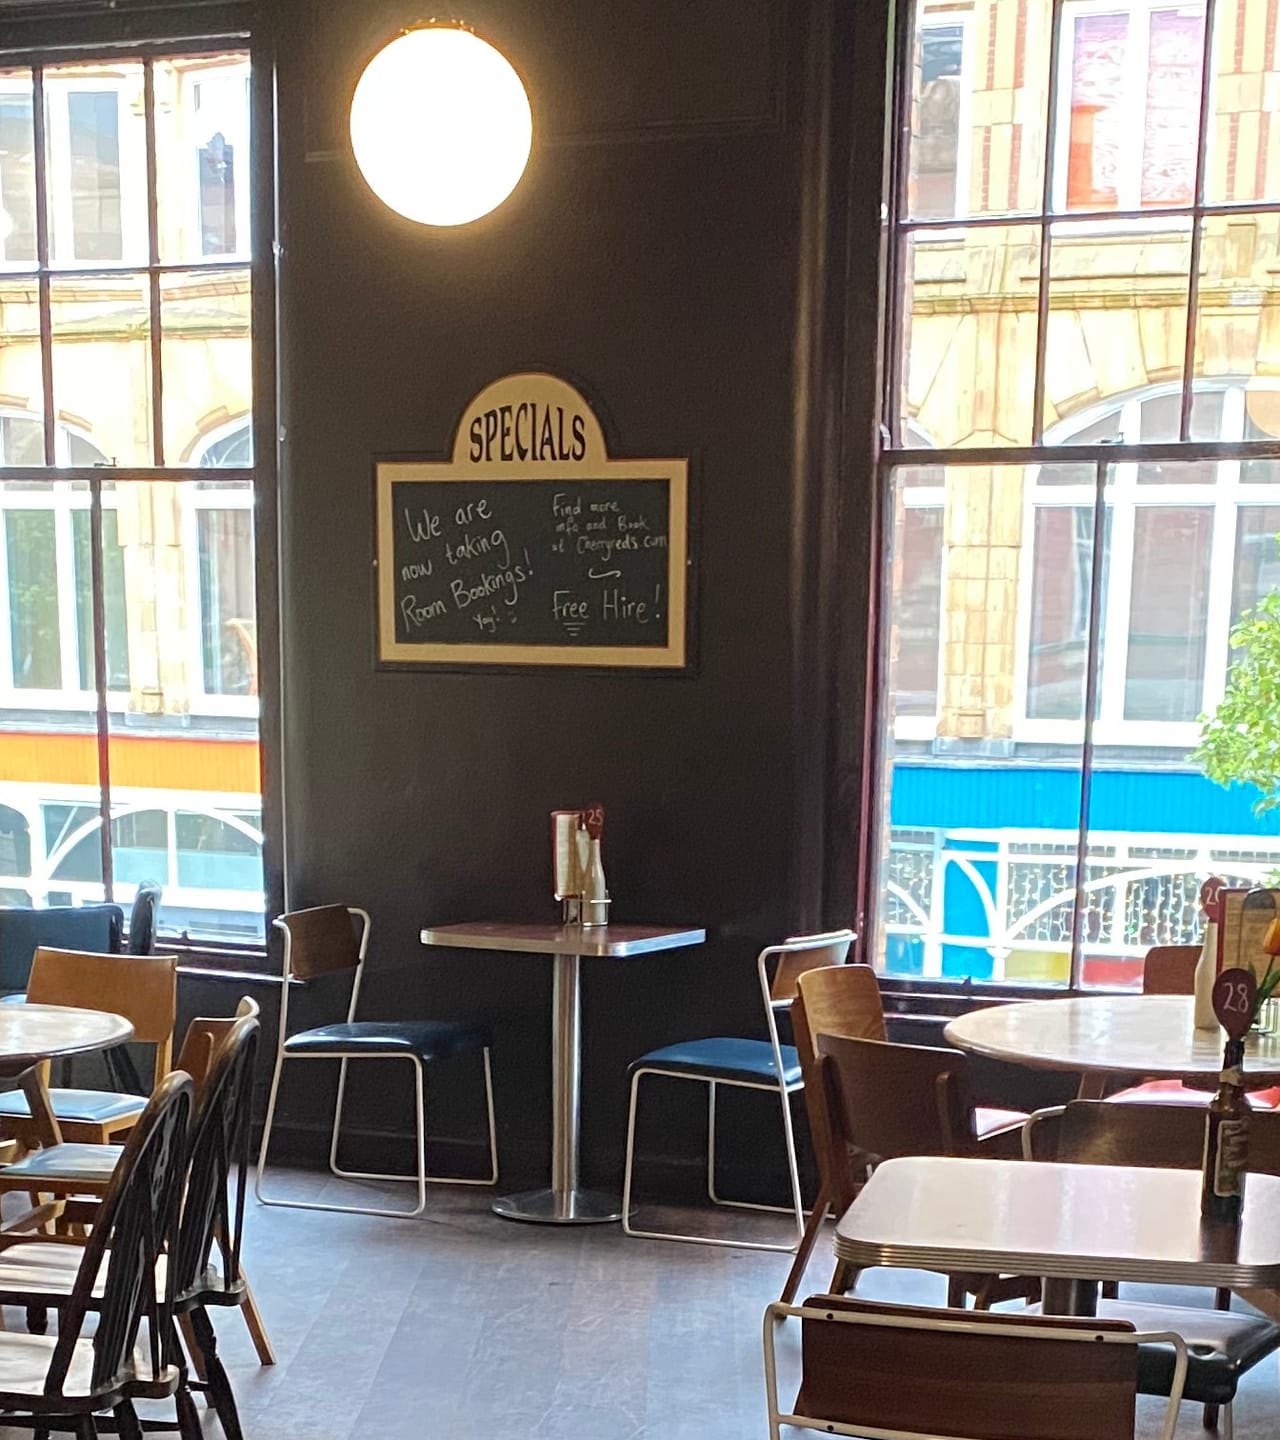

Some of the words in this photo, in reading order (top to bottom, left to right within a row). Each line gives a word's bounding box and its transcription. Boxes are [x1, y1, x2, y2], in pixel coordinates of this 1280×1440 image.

[470, 402, 586, 463] SPECIALS
[405, 507, 442, 542] We
[455, 499, 492, 525] are
[552, 493, 582, 517] Find
[590, 501, 620, 513] more
[586, 516, 607, 531] and
[401, 559, 433, 581] now
[445, 530, 510, 570] taking
[401, 594, 447, 633] Room
[450, 547, 533, 608] Bookings!
[552, 590, 590, 620] Free
[588, 808, 604, 826] 25
[1222, 981, 1250, 1014] 28
